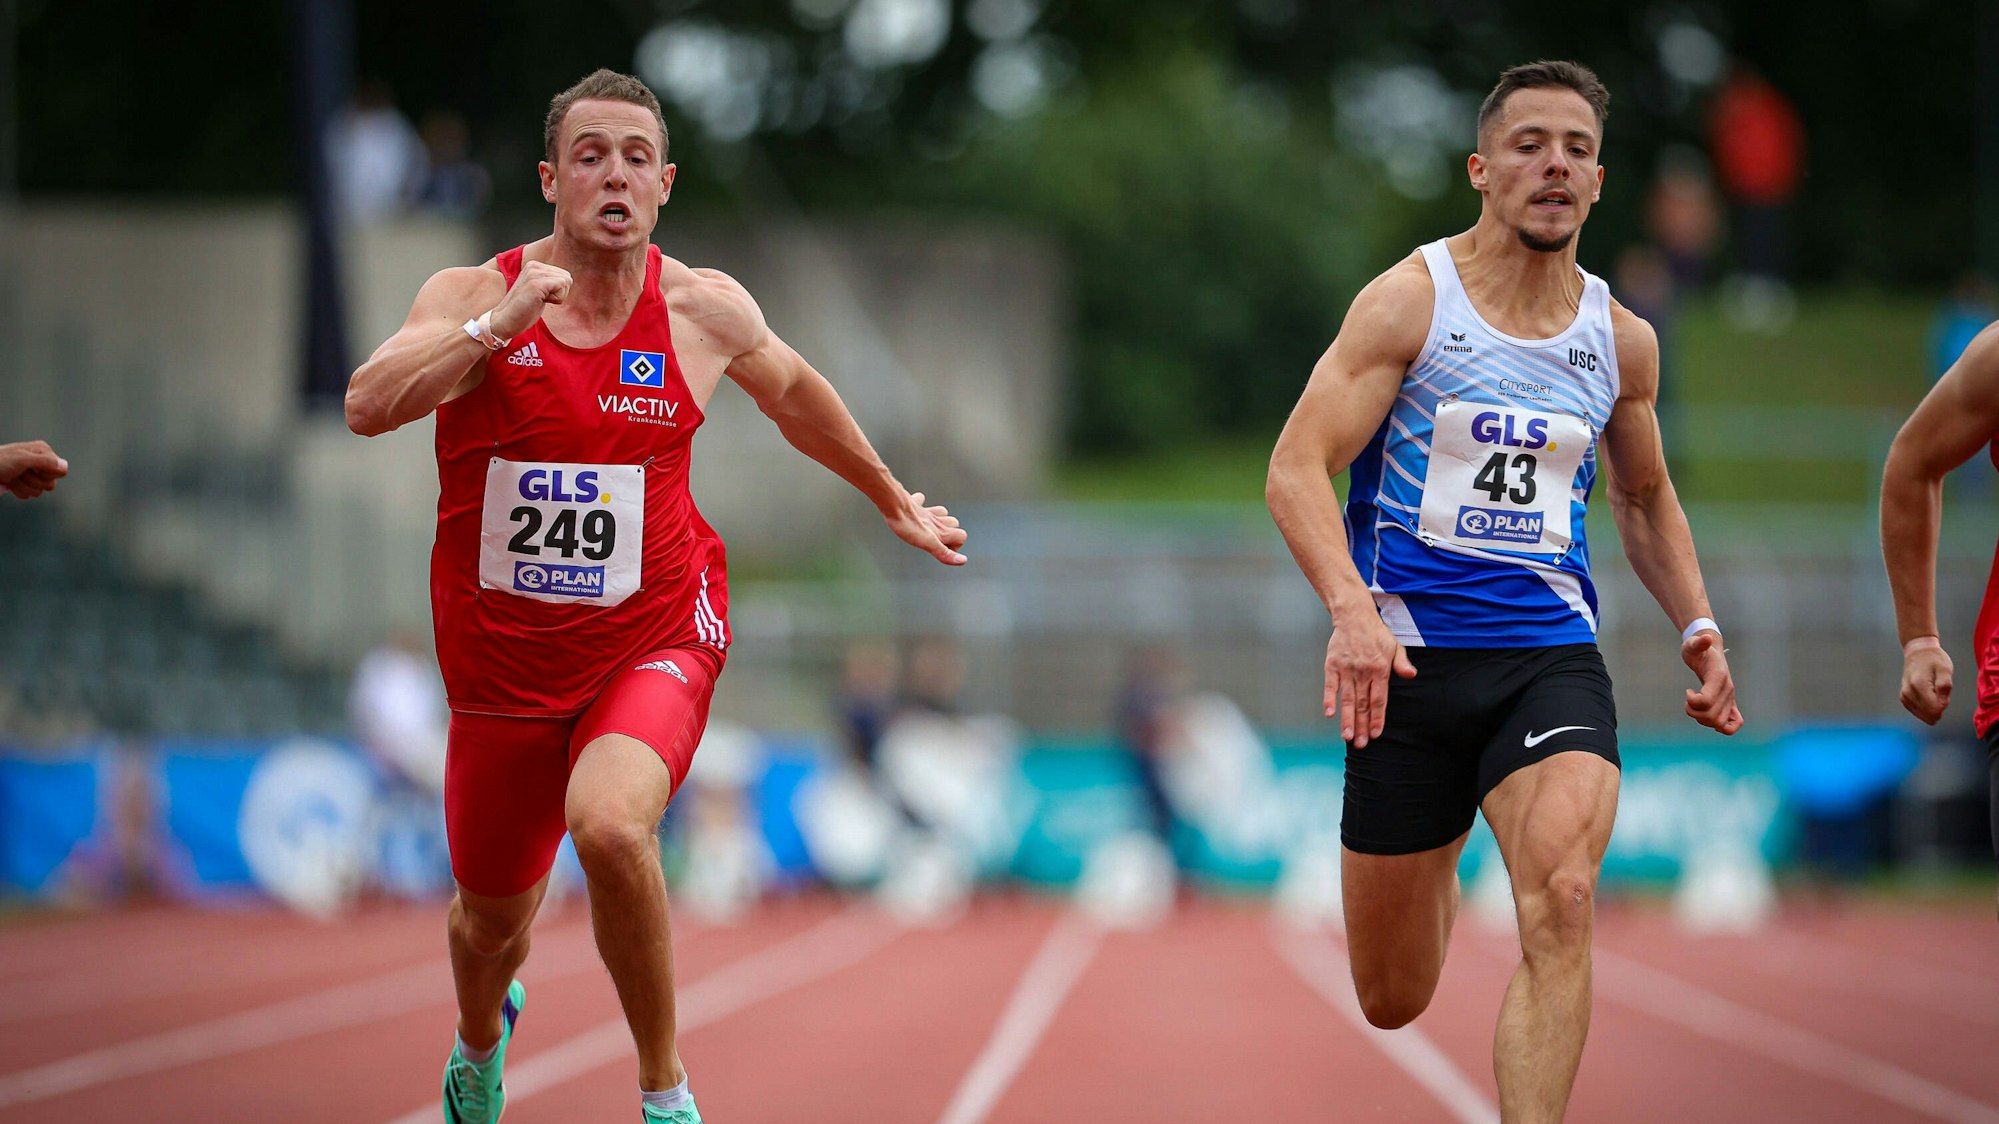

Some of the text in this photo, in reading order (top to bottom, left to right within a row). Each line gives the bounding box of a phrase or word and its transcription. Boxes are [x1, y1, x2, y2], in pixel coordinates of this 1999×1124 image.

[1443, 345, 1473, 353] erima
[507, 355, 543, 367] adidas
[1569, 348, 1597, 372] USC
[597, 394, 679, 419] VIACTIV
[628, 415, 677, 427] Krankenkasse
[1472, 451, 1538, 505] 43
[1494, 515, 1541, 533] PLAN
[507, 506, 616, 561] 249
[1493, 531, 1539, 540] INTERNATIONAL
[551, 570, 600, 587] PLAN
[551, 585, 600, 594] INTERNATIONAL
[634, 663, 688, 684] adidas
